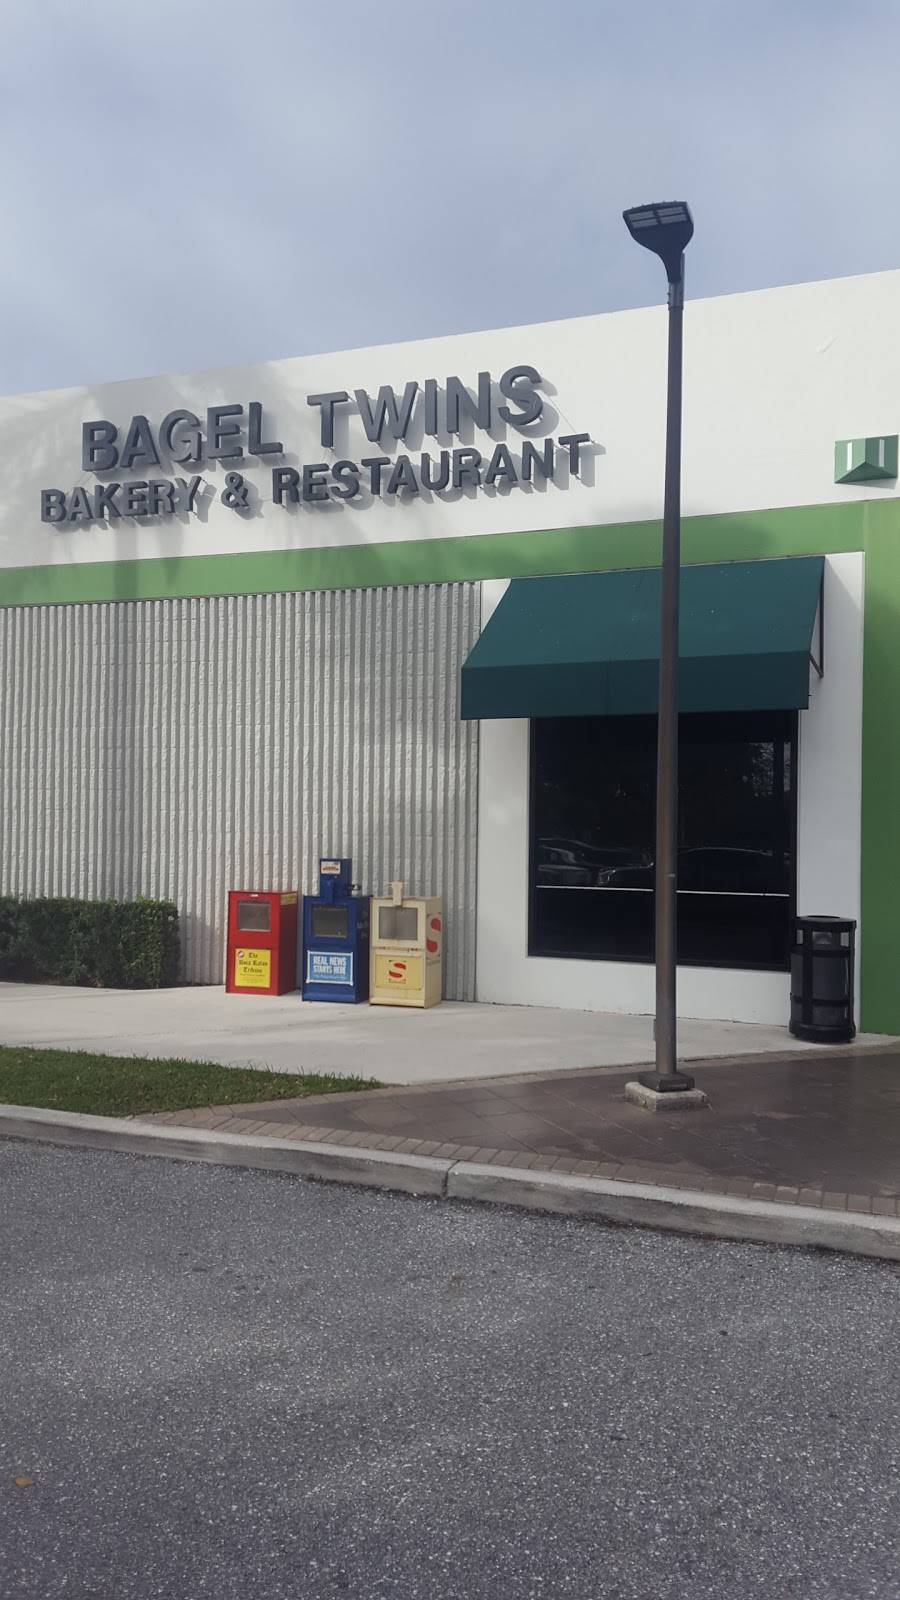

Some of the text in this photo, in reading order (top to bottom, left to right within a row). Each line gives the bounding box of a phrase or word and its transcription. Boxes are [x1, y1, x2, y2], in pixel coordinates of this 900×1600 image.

[82, 364, 544, 473] BAGEL TWINS
[40, 432, 592, 524] BAKERY & RESTAURANT
[330, 956, 346, 967] NEWS
